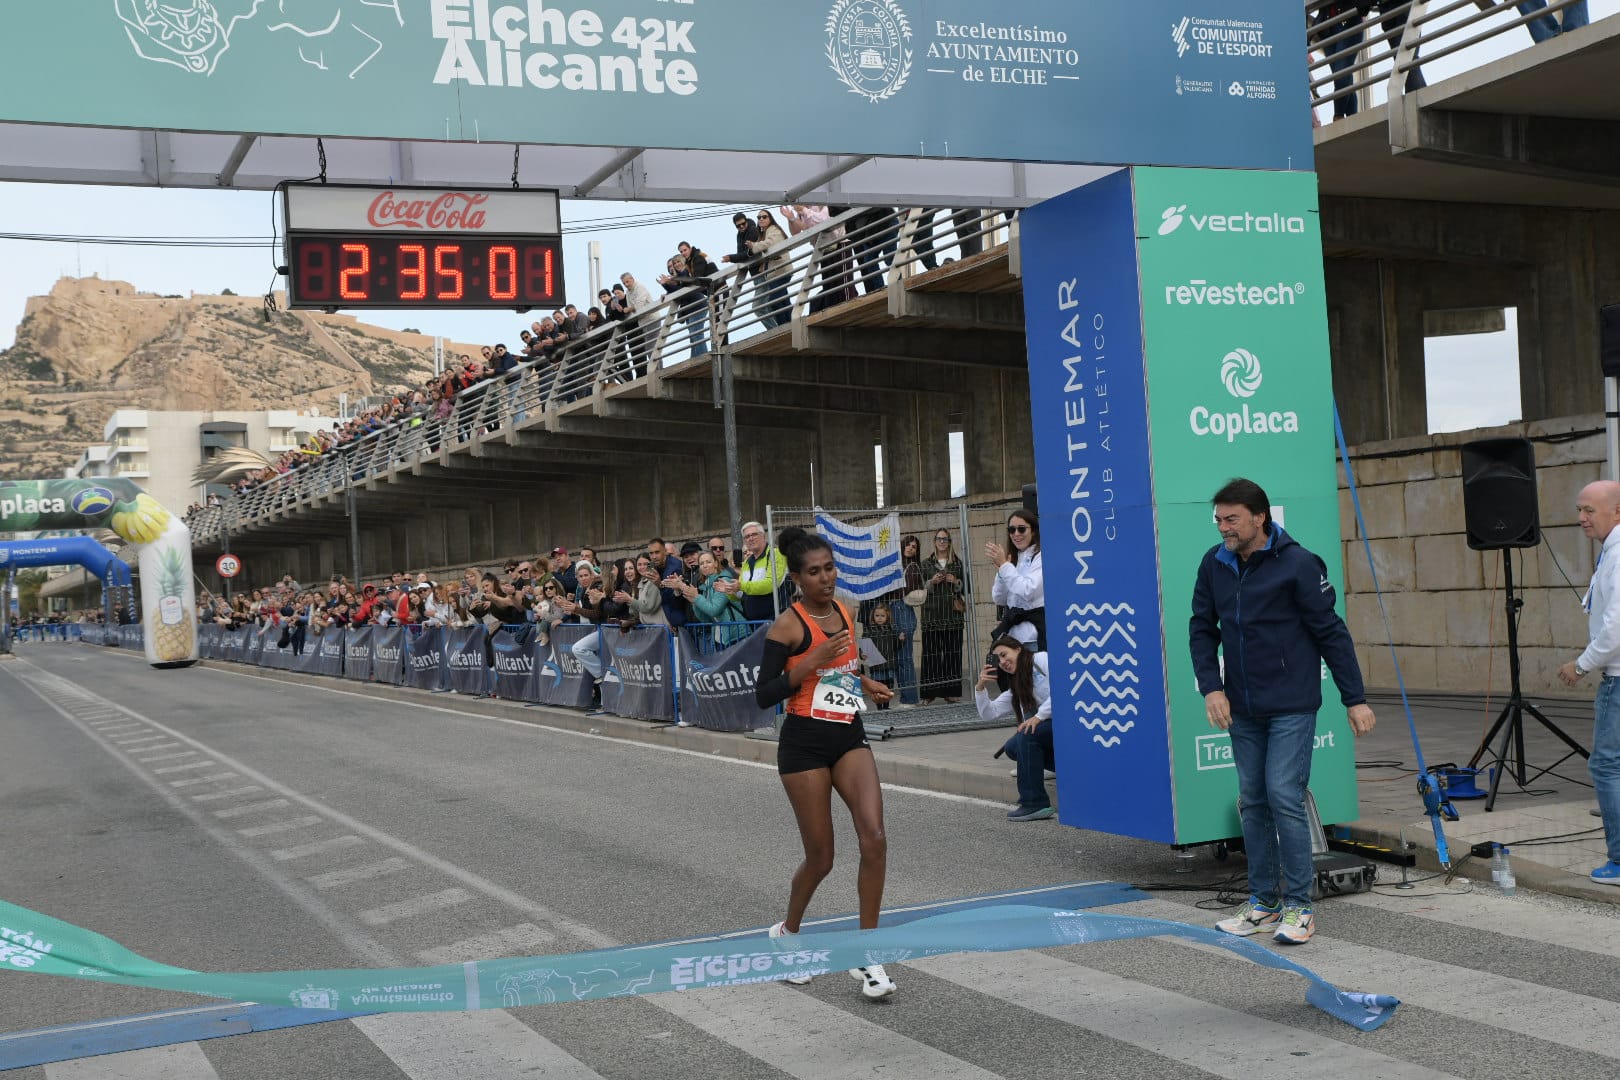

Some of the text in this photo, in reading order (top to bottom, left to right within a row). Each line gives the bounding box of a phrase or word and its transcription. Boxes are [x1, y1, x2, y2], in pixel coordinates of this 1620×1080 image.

[430, 0, 697, 54] Elche 42K
[936, 20, 1067, 44] Excelentísimo
[1191, 16, 1263, 29] Comunitat Valenciana
[1191, 27, 1263, 43] COMUNITAT
[926, 42, 1079, 66] AYUNTAMIENTO
[1198, 41, 1214, 55] DE
[432, 37, 698, 96] Alicante
[962, 64, 1048, 86] de ELCHE
[367, 191, 489, 230] Coca-Cola
[1189, 211, 1304, 233] vectalia
[1058, 277, 1095, 585] MONTEMAR
[1093, 312, 1116, 541] CLUB ATLÉTICO
[1190, 403, 1299, 443] Coplaca
